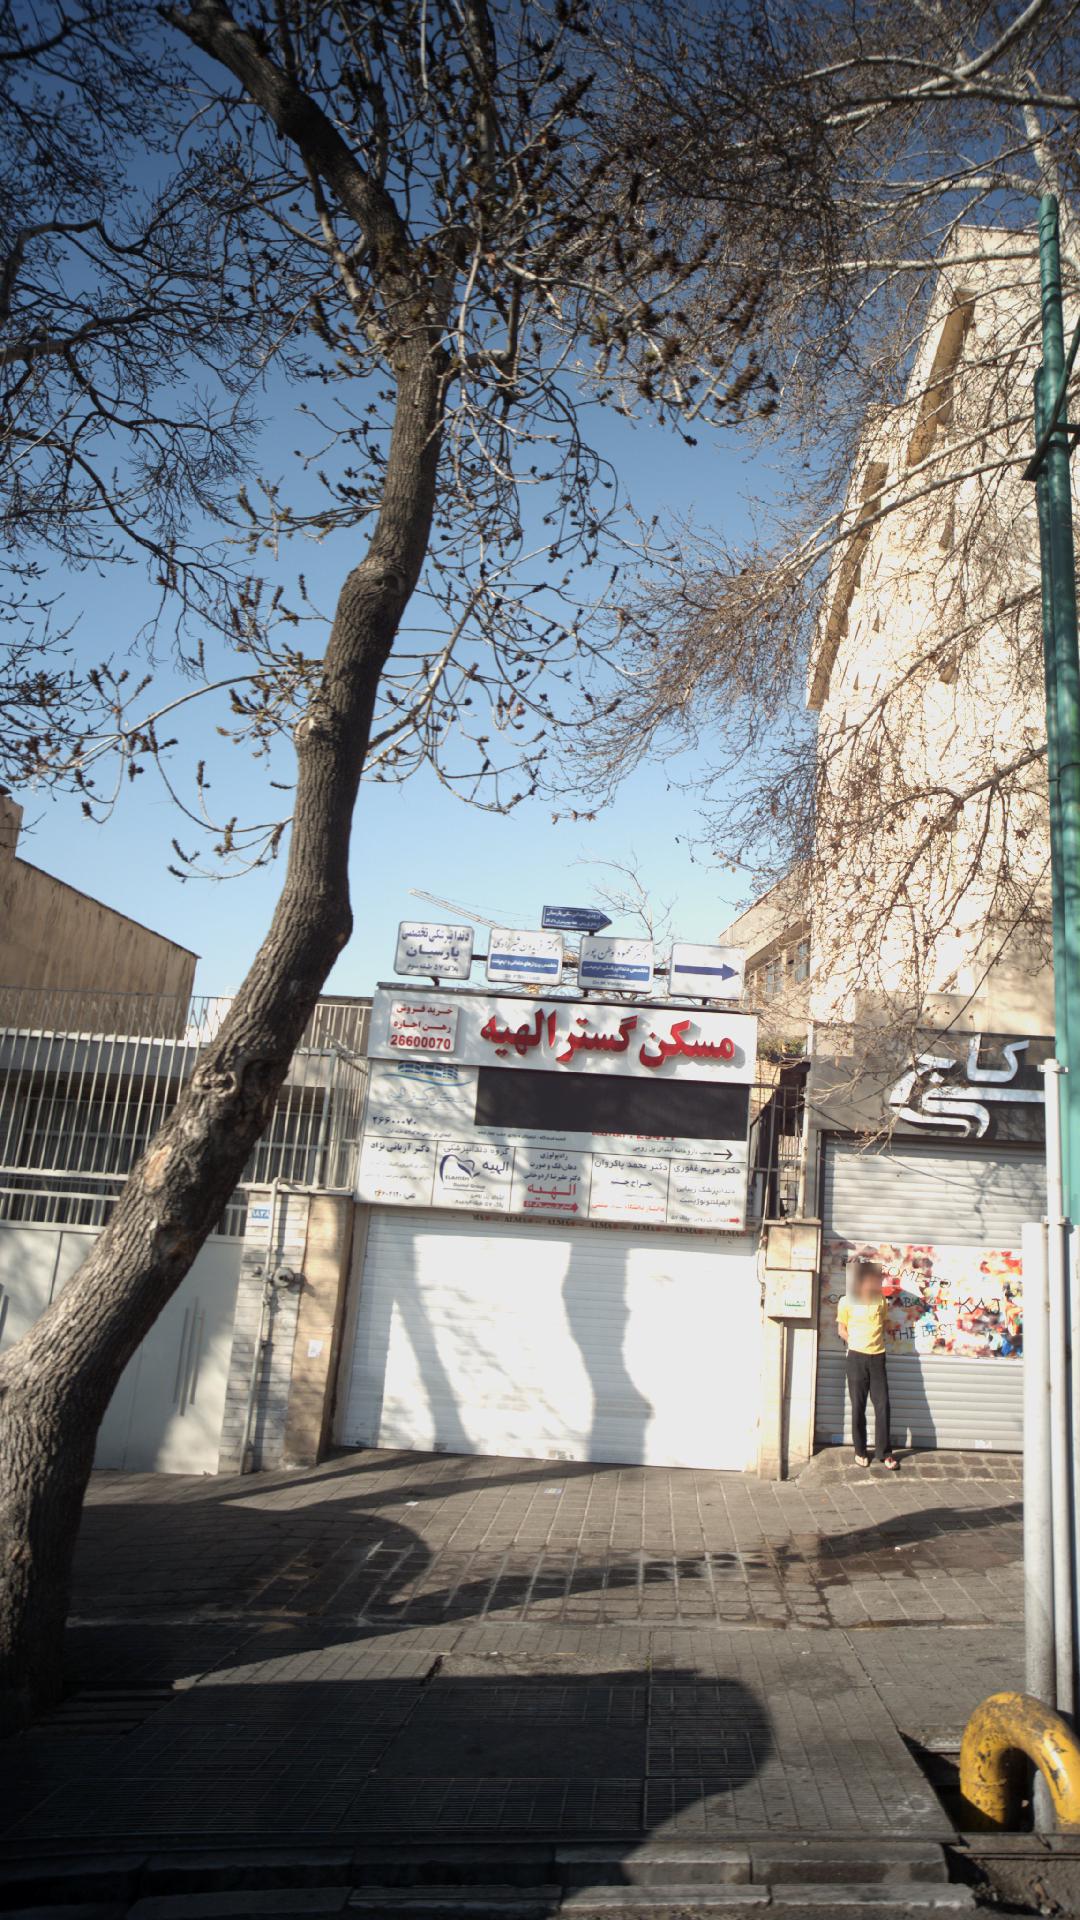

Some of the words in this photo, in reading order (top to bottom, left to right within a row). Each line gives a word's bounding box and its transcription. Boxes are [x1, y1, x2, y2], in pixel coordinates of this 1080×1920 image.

[405, 945, 460, 962] پارسیان
[428, 1007, 453, 1016] خرید
[393, 1020, 421, 1030] اجاره
[480, 1008, 557, 1056] الهیه
[390, 1034, 451, 1050] 26600070
[556, 1015, 639, 1064] گستر
[639, 1019, 735, 1068] مسکن
[412, 1144, 430, 1154] دکتر
[490, 1147, 510, 1157] گروه
[540, 1152, 568, 1160] رادیولوژی
[482, 1160, 510, 1174] الهیه
[649, 1163, 668, 1172] دکتر
[721, 1166, 741, 1175] دکتر
[527, 1183, 577, 1200] الهیه
[958, 1297, 1001, 1315] KAJ
